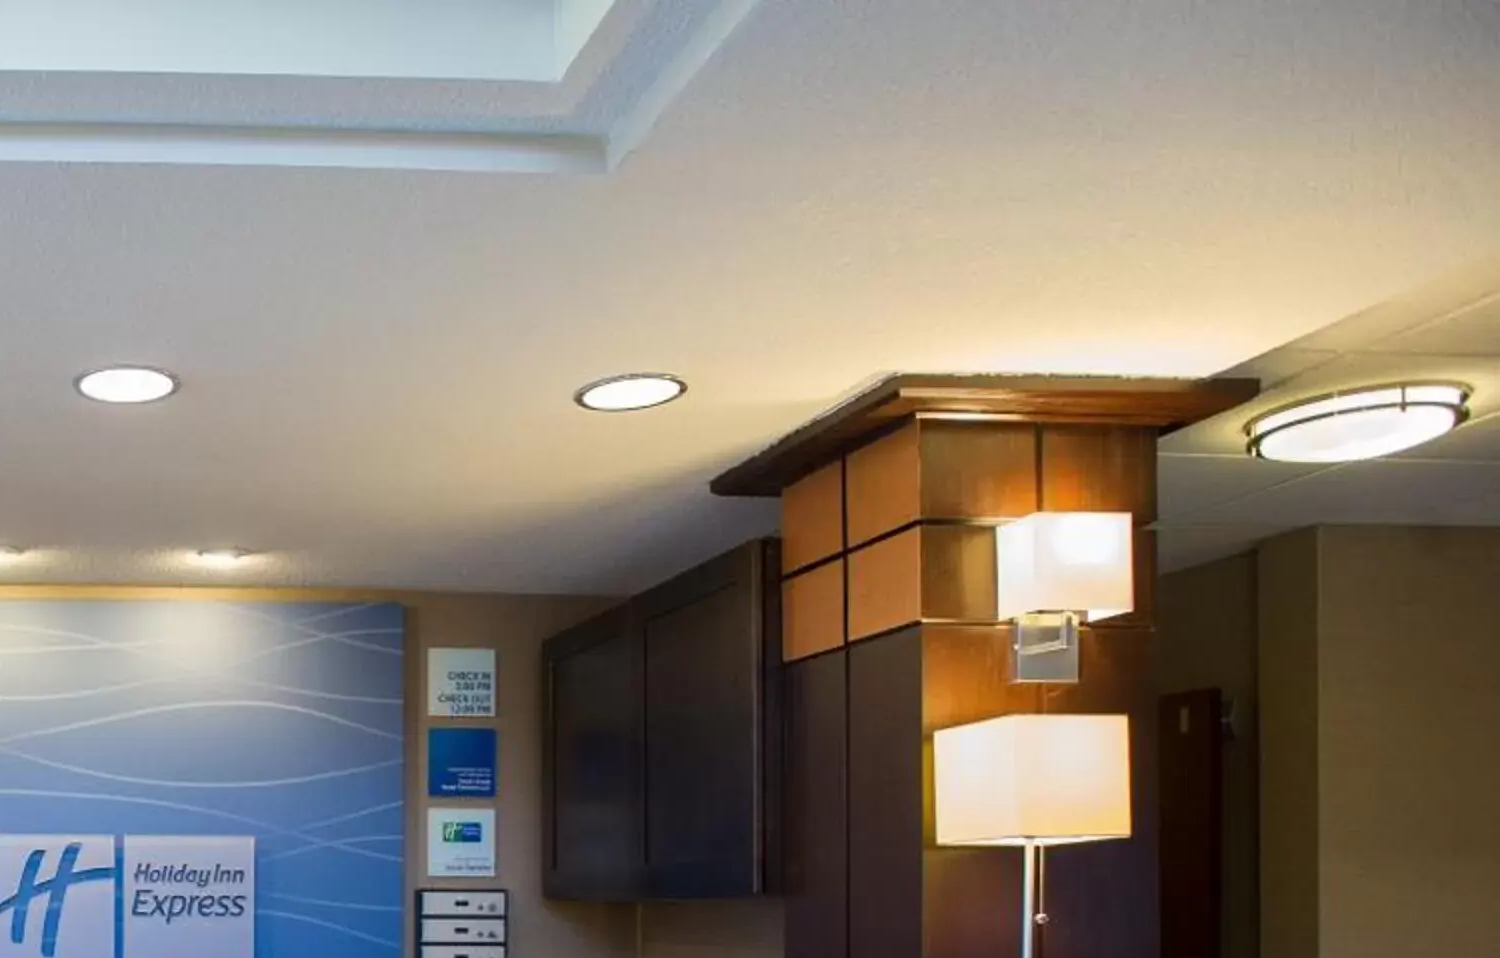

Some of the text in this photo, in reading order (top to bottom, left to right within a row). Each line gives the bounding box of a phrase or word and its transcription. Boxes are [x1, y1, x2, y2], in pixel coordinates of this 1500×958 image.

[447, 671, 479, 681] CHECK
[133, 863, 245, 888] Holiday Inn
[131, 889, 248, 925] Express
